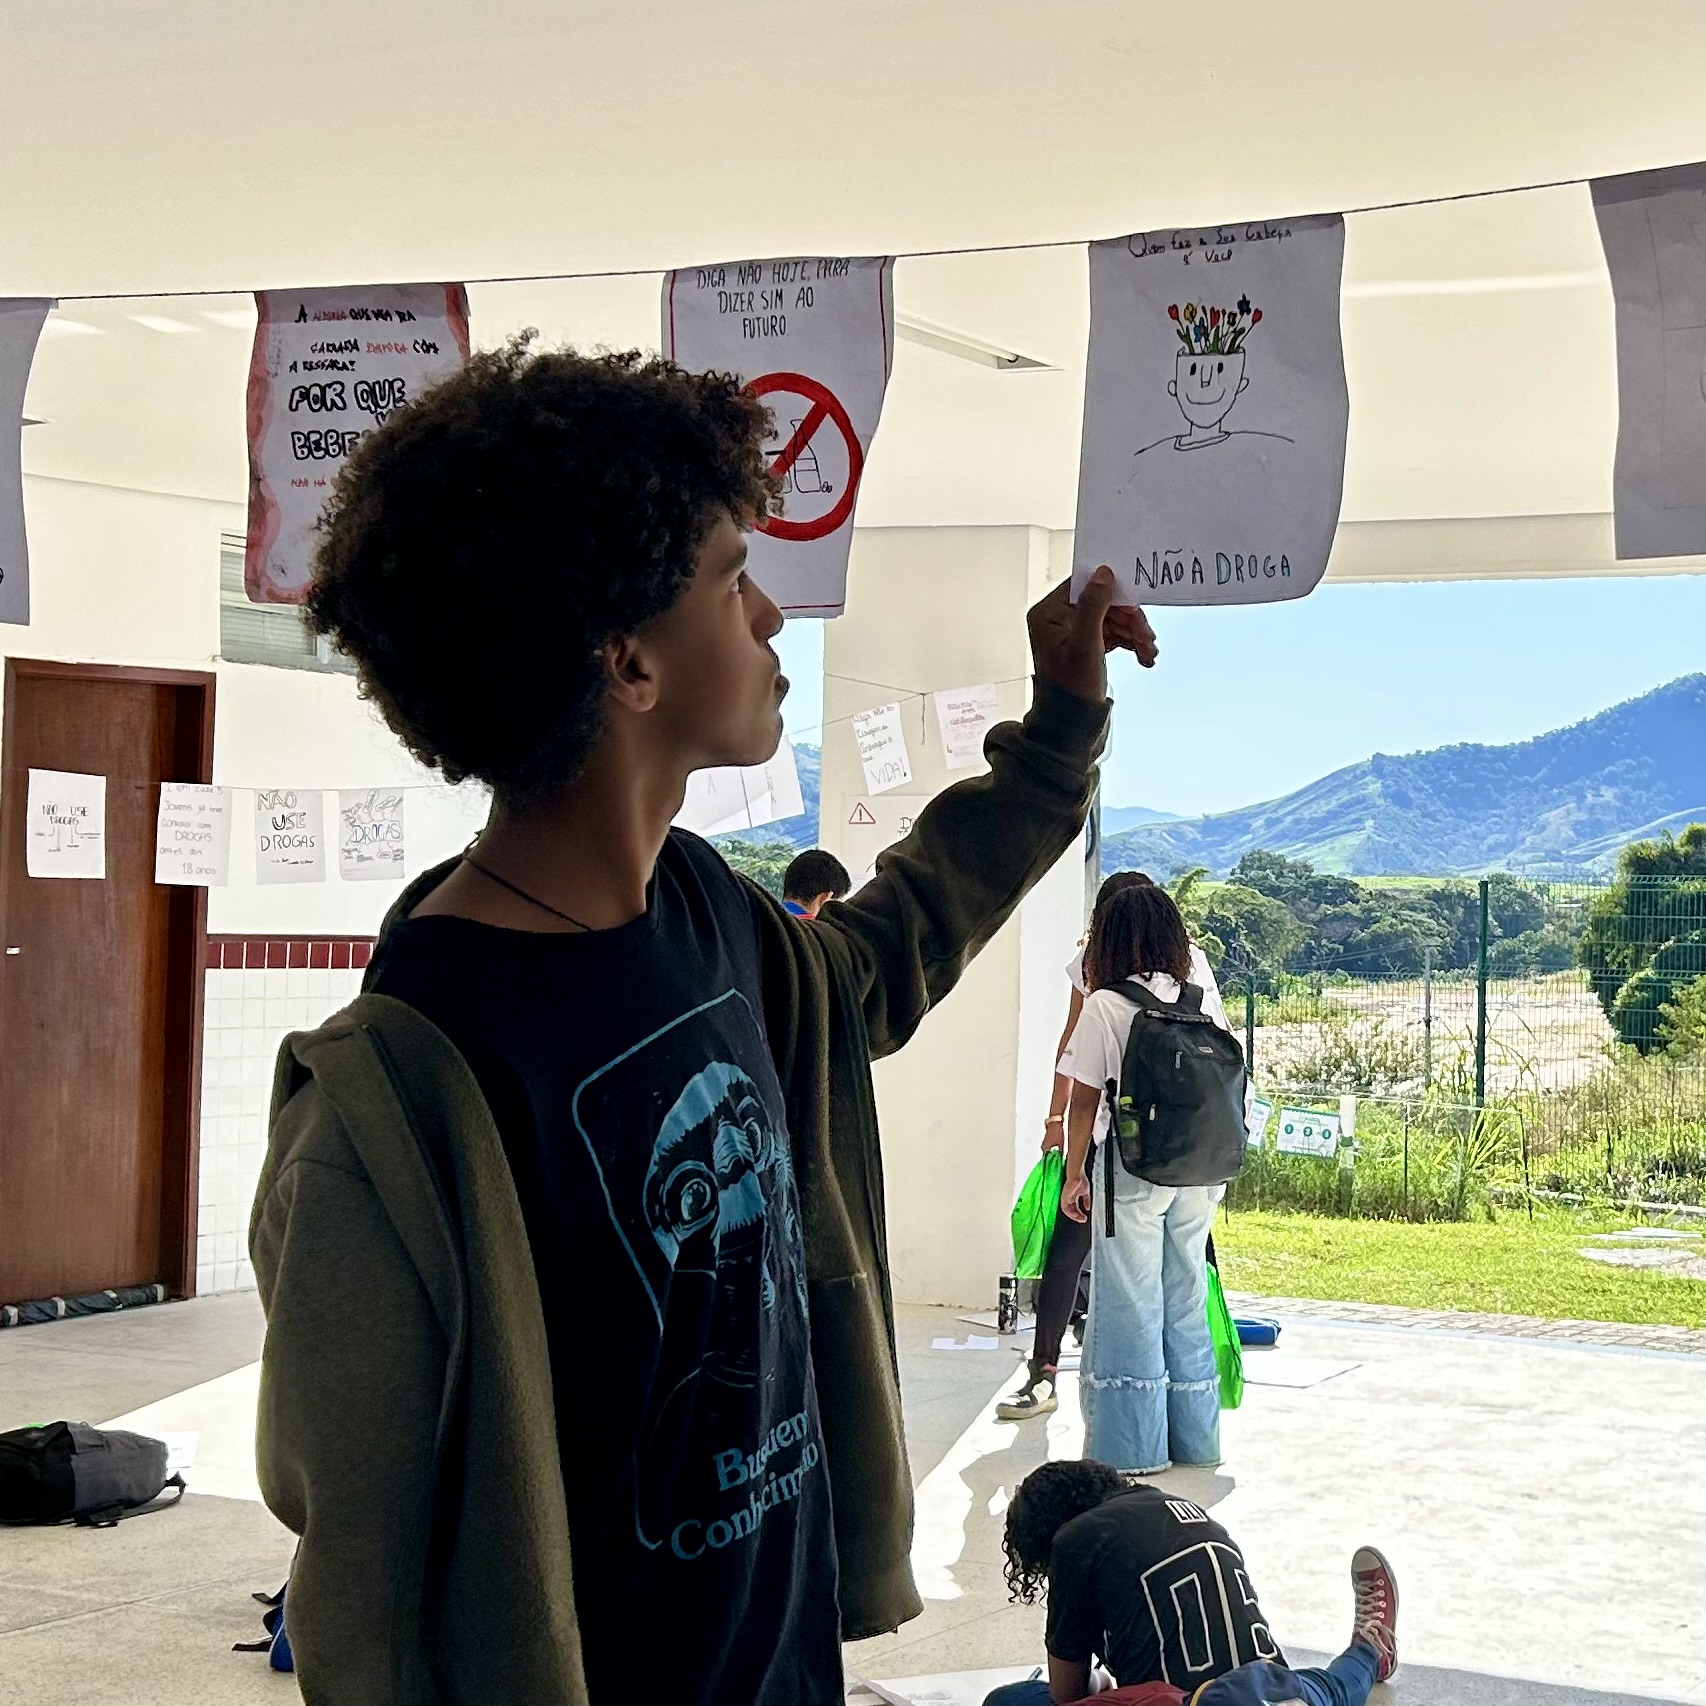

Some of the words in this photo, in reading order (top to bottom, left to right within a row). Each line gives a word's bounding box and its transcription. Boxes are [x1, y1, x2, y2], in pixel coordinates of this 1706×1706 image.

[697, 267, 726, 290] DIGA
[717, 290, 755, 314] DIZER
[760, 287, 783, 311] SIM
[795, 286, 814, 309] AO
[294, 304, 308, 323] A
[288, 360, 298, 373] A
[288, 381, 347, 412] POR
[353, 377, 408, 414] QUE
[291, 429, 367, 460] BEBE
[1134, 549, 1184, 590] NÃO
[1216, 551, 1291, 585] DROGA
[257, 789, 298, 811] NÃO
[271, 811, 307, 831] USE
[175, 829, 213, 842] DROGAS
[260, 834, 317, 852] DROGAS
[182, 862, 194, 875] 18
